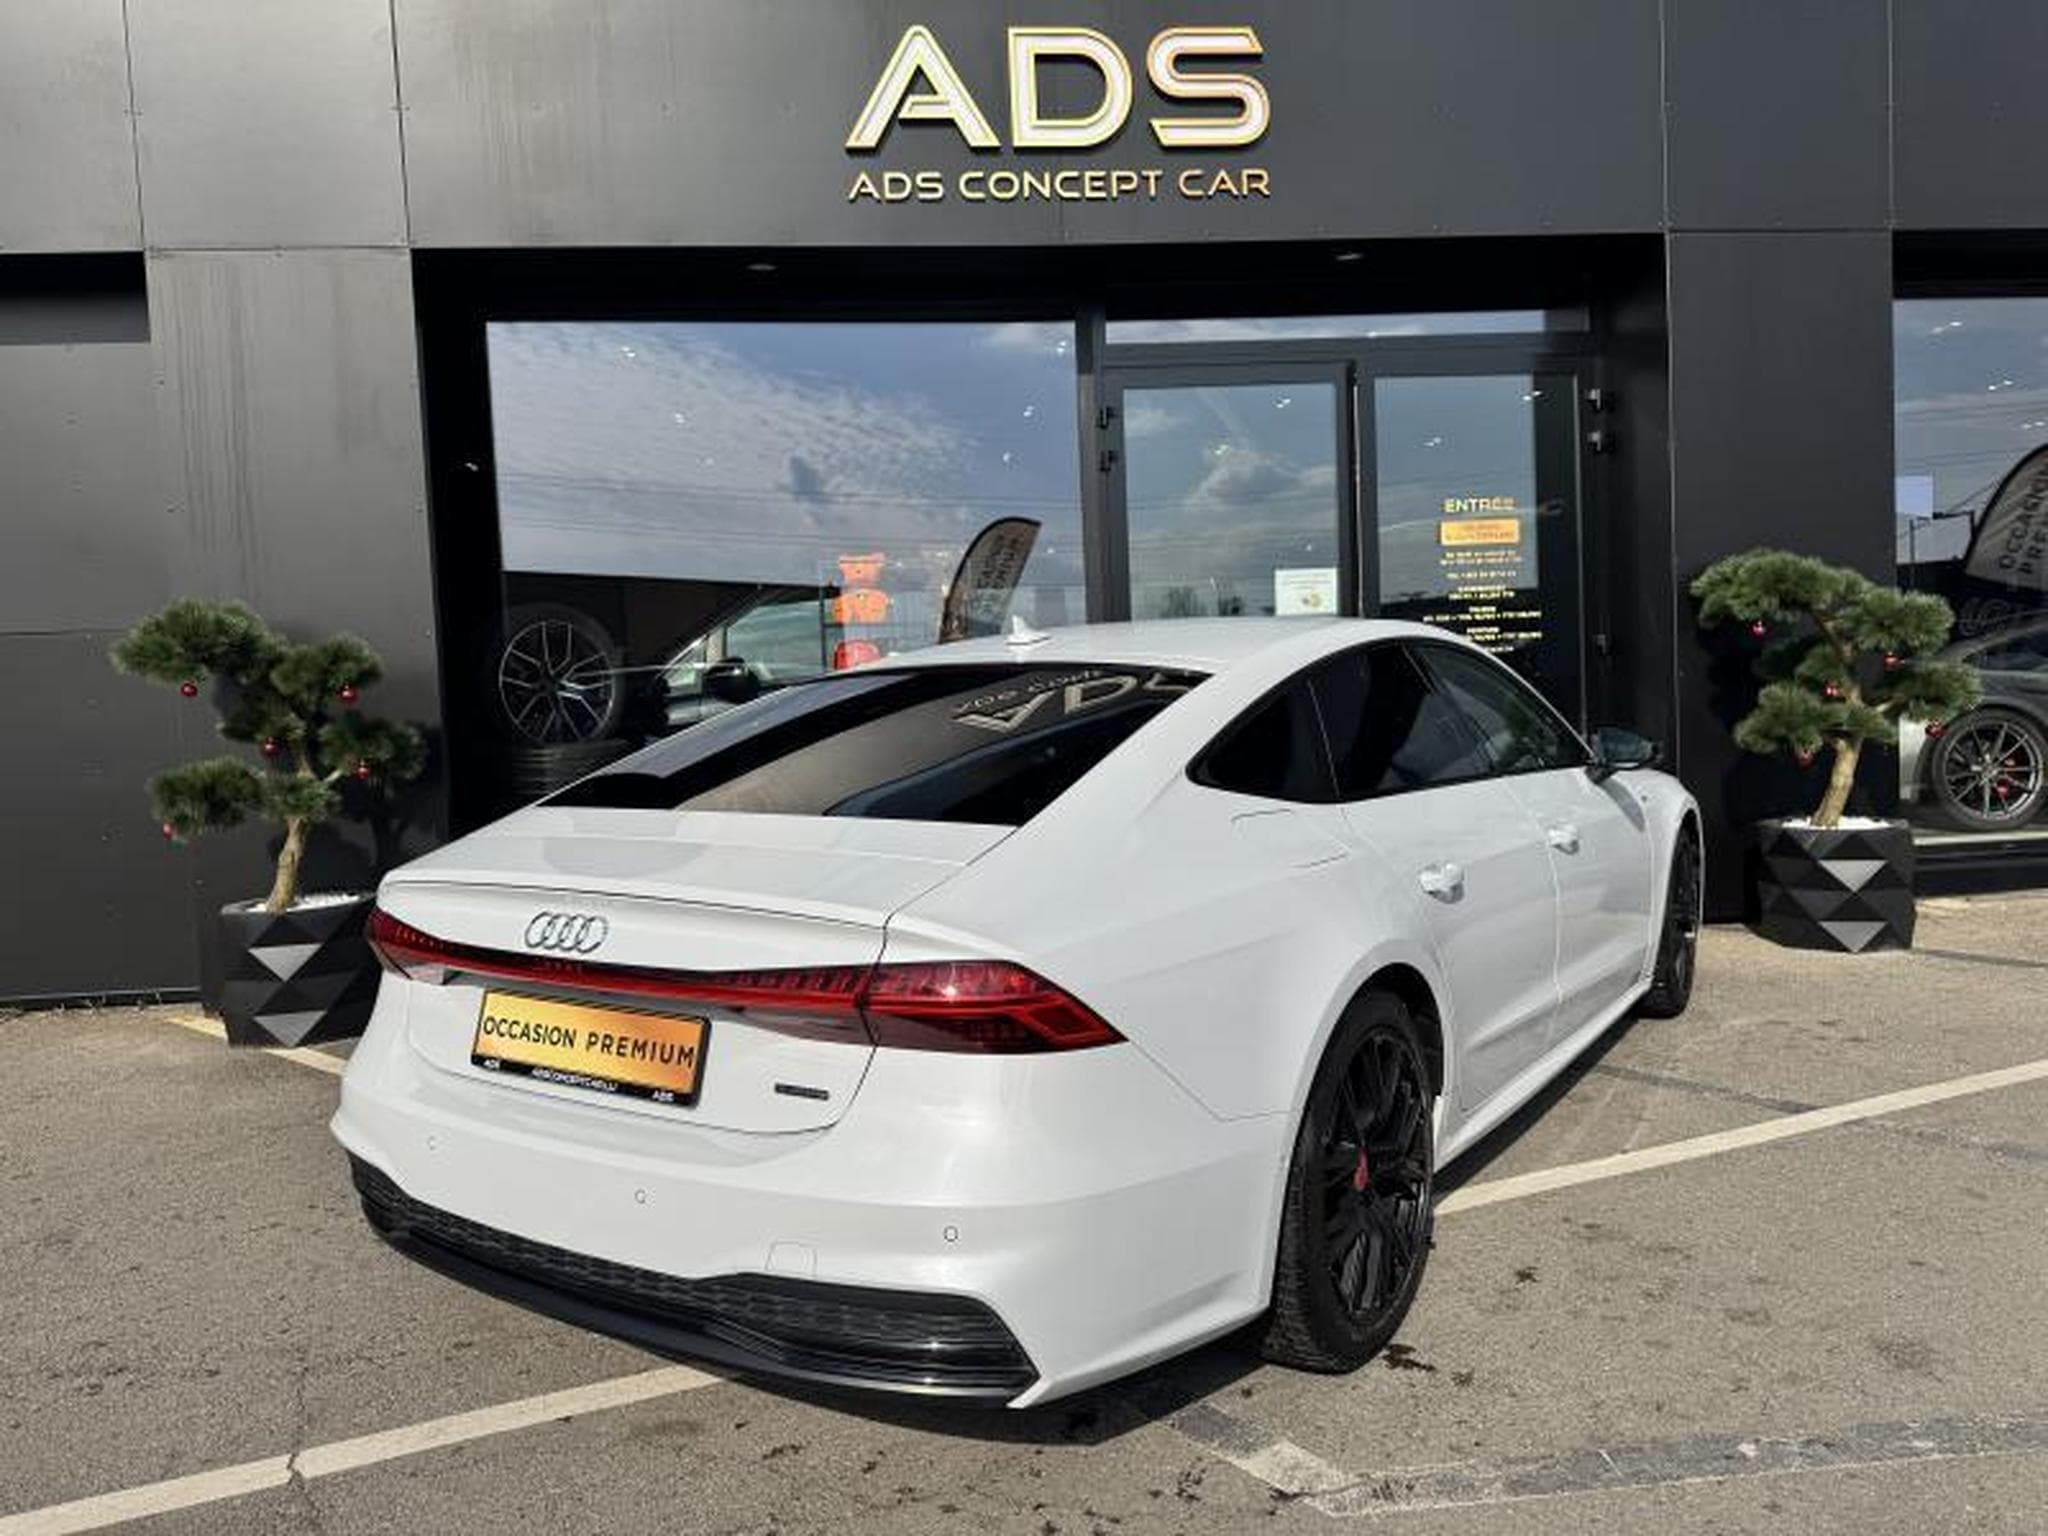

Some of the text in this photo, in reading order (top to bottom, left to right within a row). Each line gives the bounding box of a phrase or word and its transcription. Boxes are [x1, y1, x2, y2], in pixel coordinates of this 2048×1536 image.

[845, 24, 1271, 149] ADS
[848, 168, 1271, 201] ADS CONCEPT CAR
[482, 1014, 695, 1069] OCCASION PREMIUM
